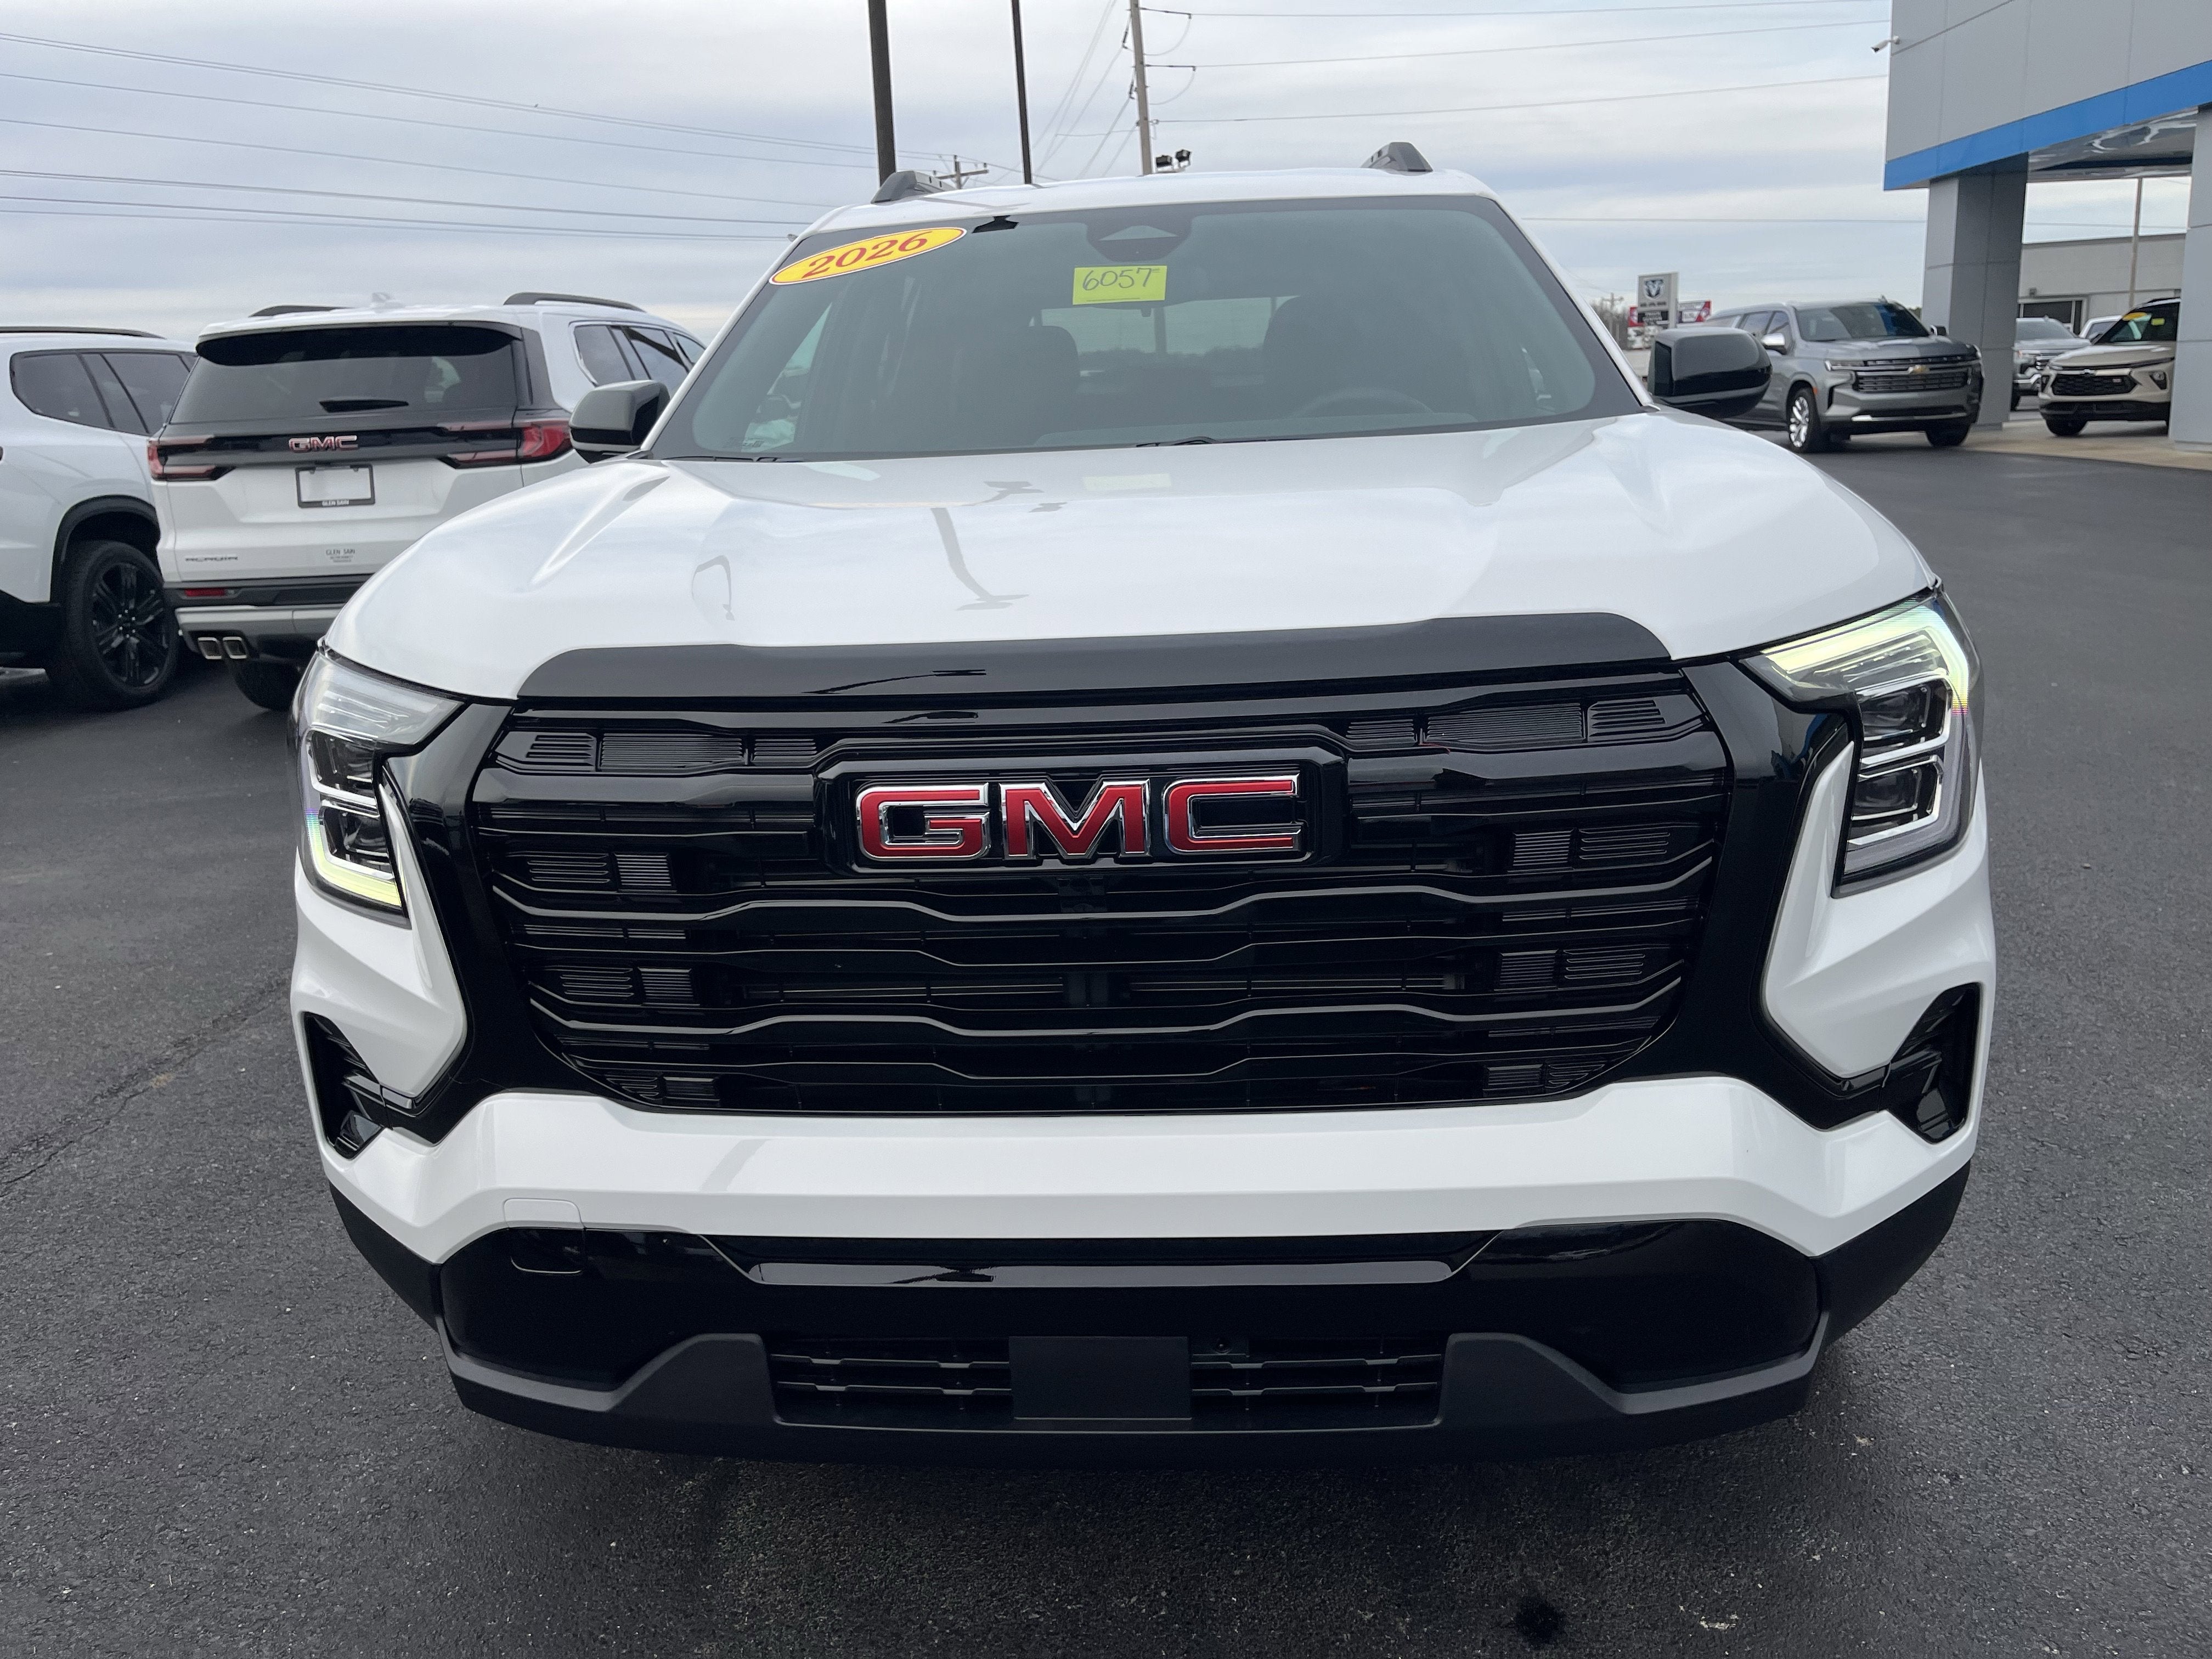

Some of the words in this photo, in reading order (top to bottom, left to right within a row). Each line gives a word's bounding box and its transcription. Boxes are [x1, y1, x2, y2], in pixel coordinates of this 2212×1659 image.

[802, 231, 933, 279] 2026
[1082, 267, 1152, 291] 6057
[289, 435, 359, 453] GMC
[856, 772, 1302, 862] GMC
